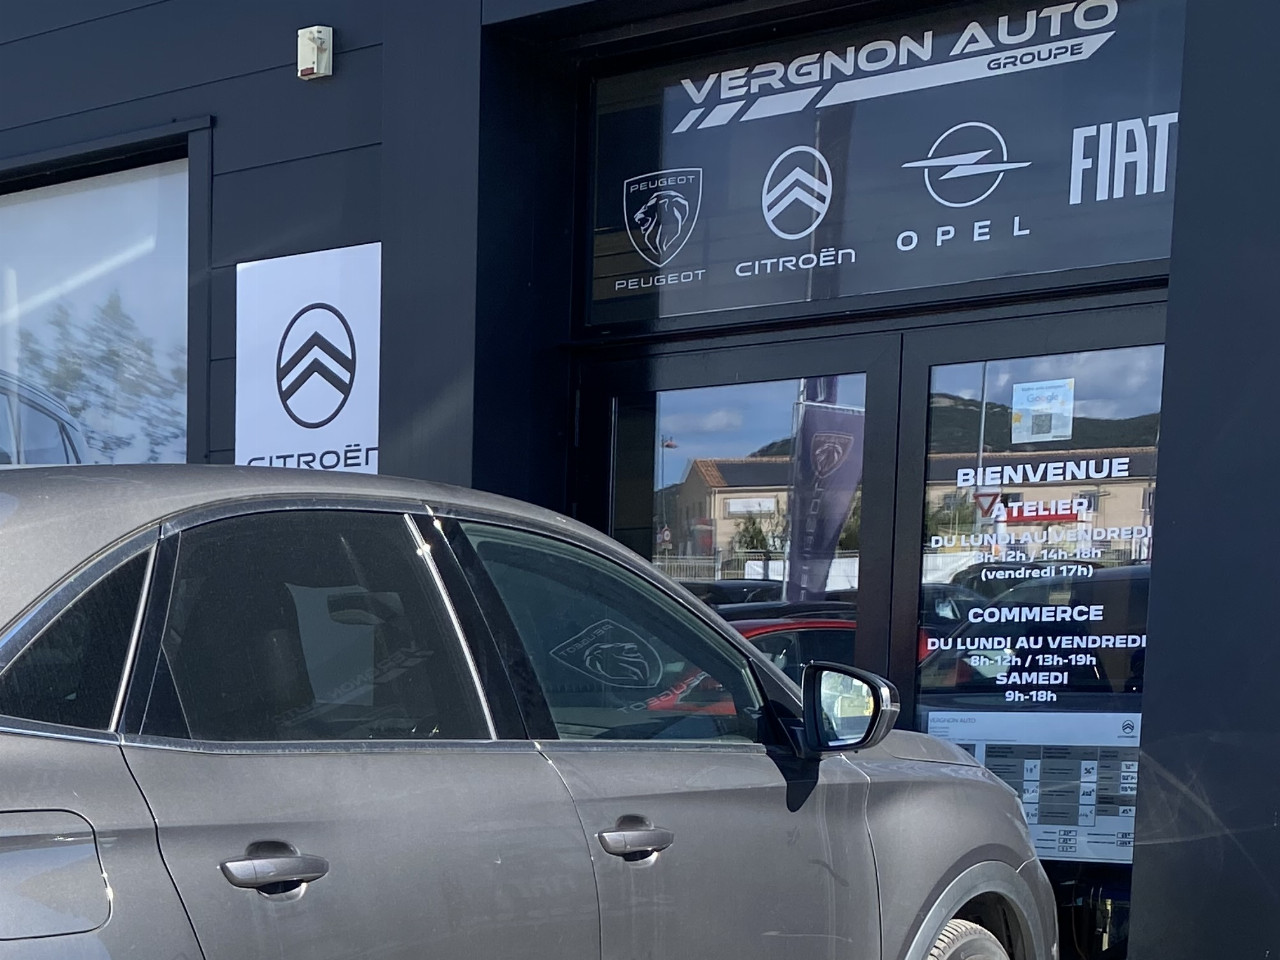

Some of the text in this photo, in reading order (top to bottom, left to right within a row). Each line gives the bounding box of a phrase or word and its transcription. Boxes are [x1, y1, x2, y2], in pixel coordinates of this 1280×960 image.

[680, 0, 1119, 104] VERGNON AUTO
[986, 42, 1085, 71] GROUPE
[1069, 113, 1179, 205] FIAT
[629, 174, 696, 193] PEUGEOT
[896, 216, 1031, 251] OPEL
[615, 269, 706, 291] PEUGEOT
[956, 457, 1130, 488] BIENVENUE
[990, 498, 1089, 519] ATELIER
[931, 526, 1152, 548] DU LUNDI AU VENDREDI
[1040, 548, 1101, 561] 14h-18h
[981, 564, 1094, 582] (vendredi 17h)
[968, 605, 1104, 624] COMMERCE
[927, 635, 1146, 651] DU LUNDI AU VENDREDI
[970, 654, 1021, 667] 8h-12h
[1035, 653, 1096, 666] 13h-19h
[995, 671, 1068, 685] SAMEDI
[1005, 690, 1057, 702] 9h-18h
